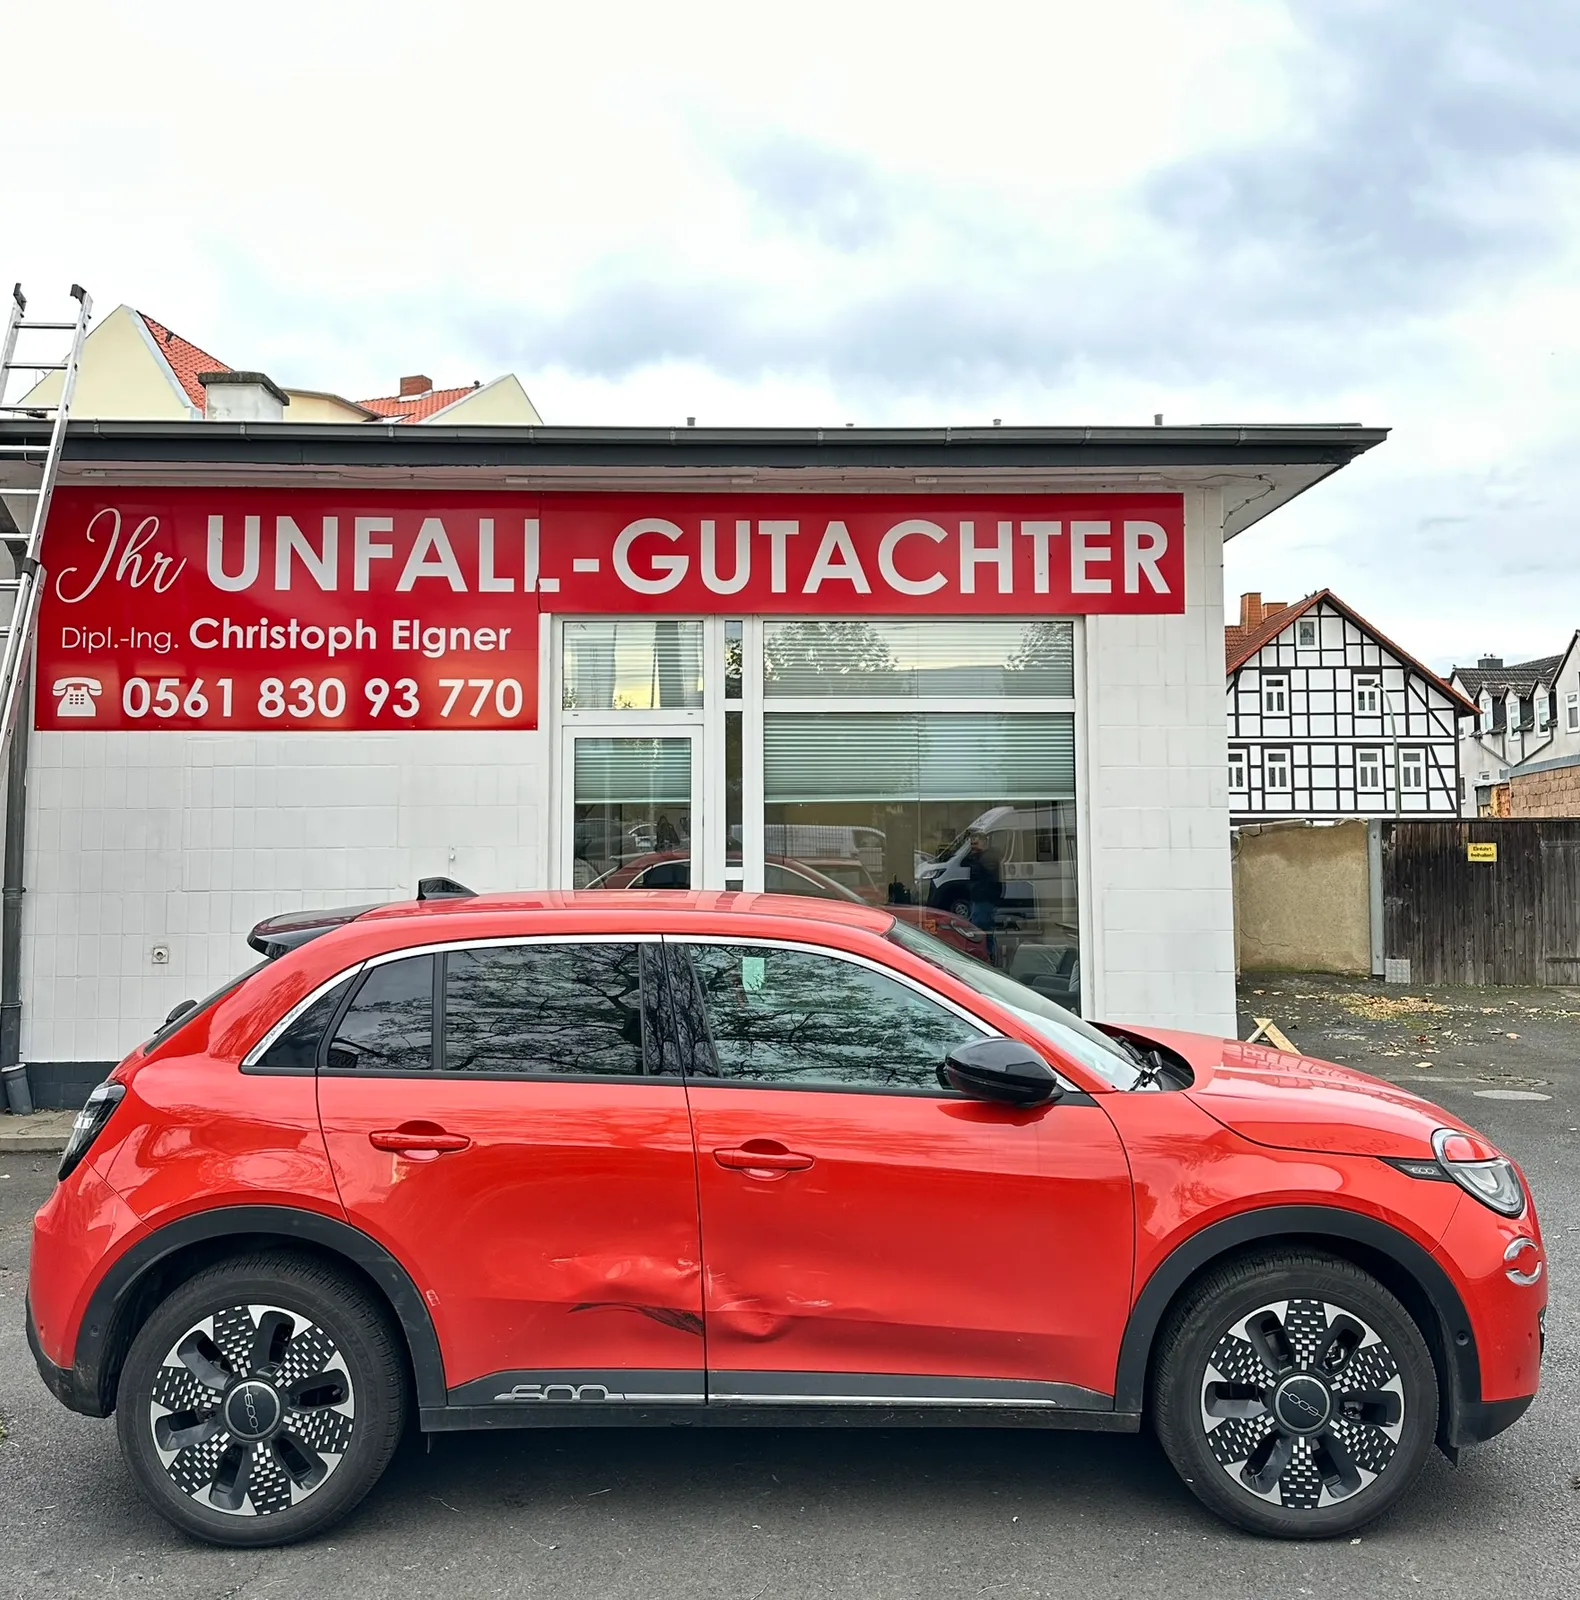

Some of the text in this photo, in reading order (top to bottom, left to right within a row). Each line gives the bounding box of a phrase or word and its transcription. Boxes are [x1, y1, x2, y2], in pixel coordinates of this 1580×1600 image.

[56, 508, 187, 604] Ihr
[62, 618, 512, 658] Dipl.-Ing. Christoph Elgner
[122, 678, 523, 718] 0561 830 93 770
